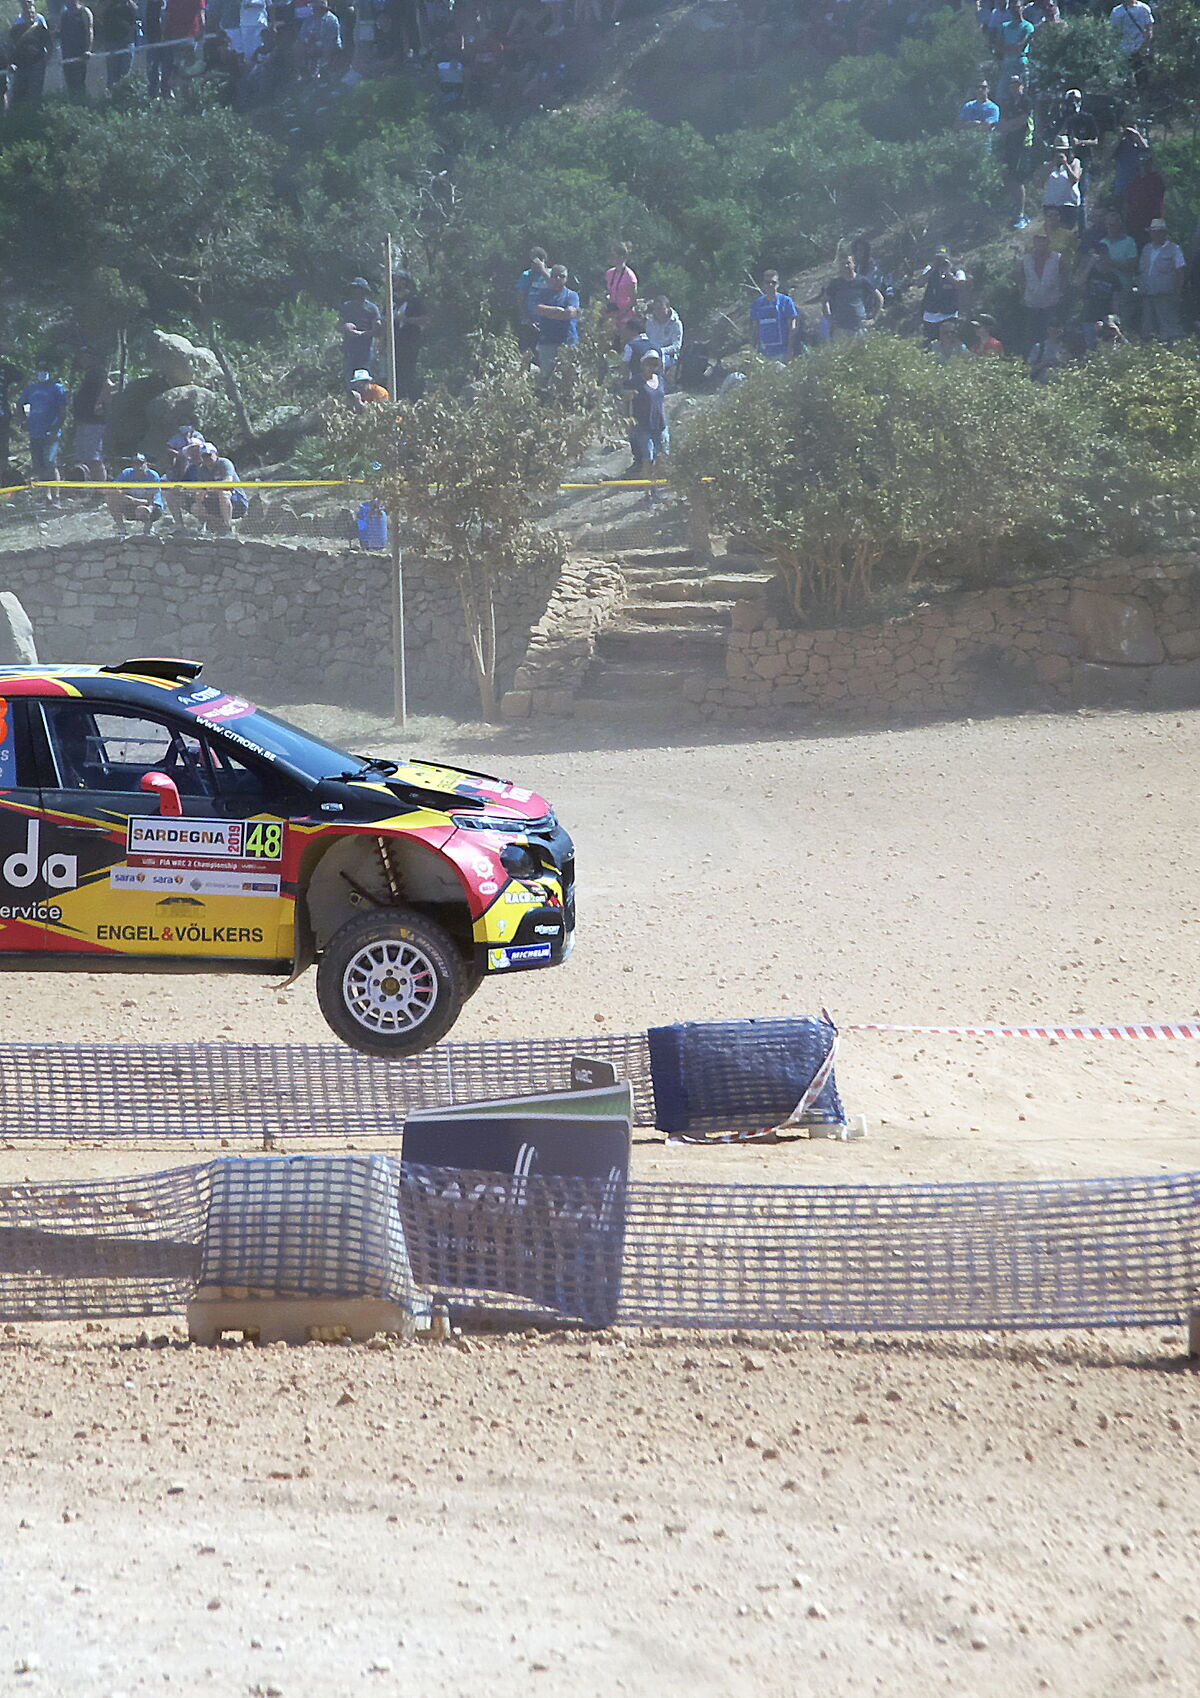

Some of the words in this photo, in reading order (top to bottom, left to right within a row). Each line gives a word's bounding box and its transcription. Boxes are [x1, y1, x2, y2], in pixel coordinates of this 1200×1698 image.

[133, 828, 225, 844] SARDEGNA
[227, 825, 241, 853] 2019
[246, 824, 281, 858] 48
[193, 860, 238, 870] Championship
[114, 873, 135, 882] sara
[152, 875, 174, 884] sara
[511, 948, 550, 960] MICHELIN
